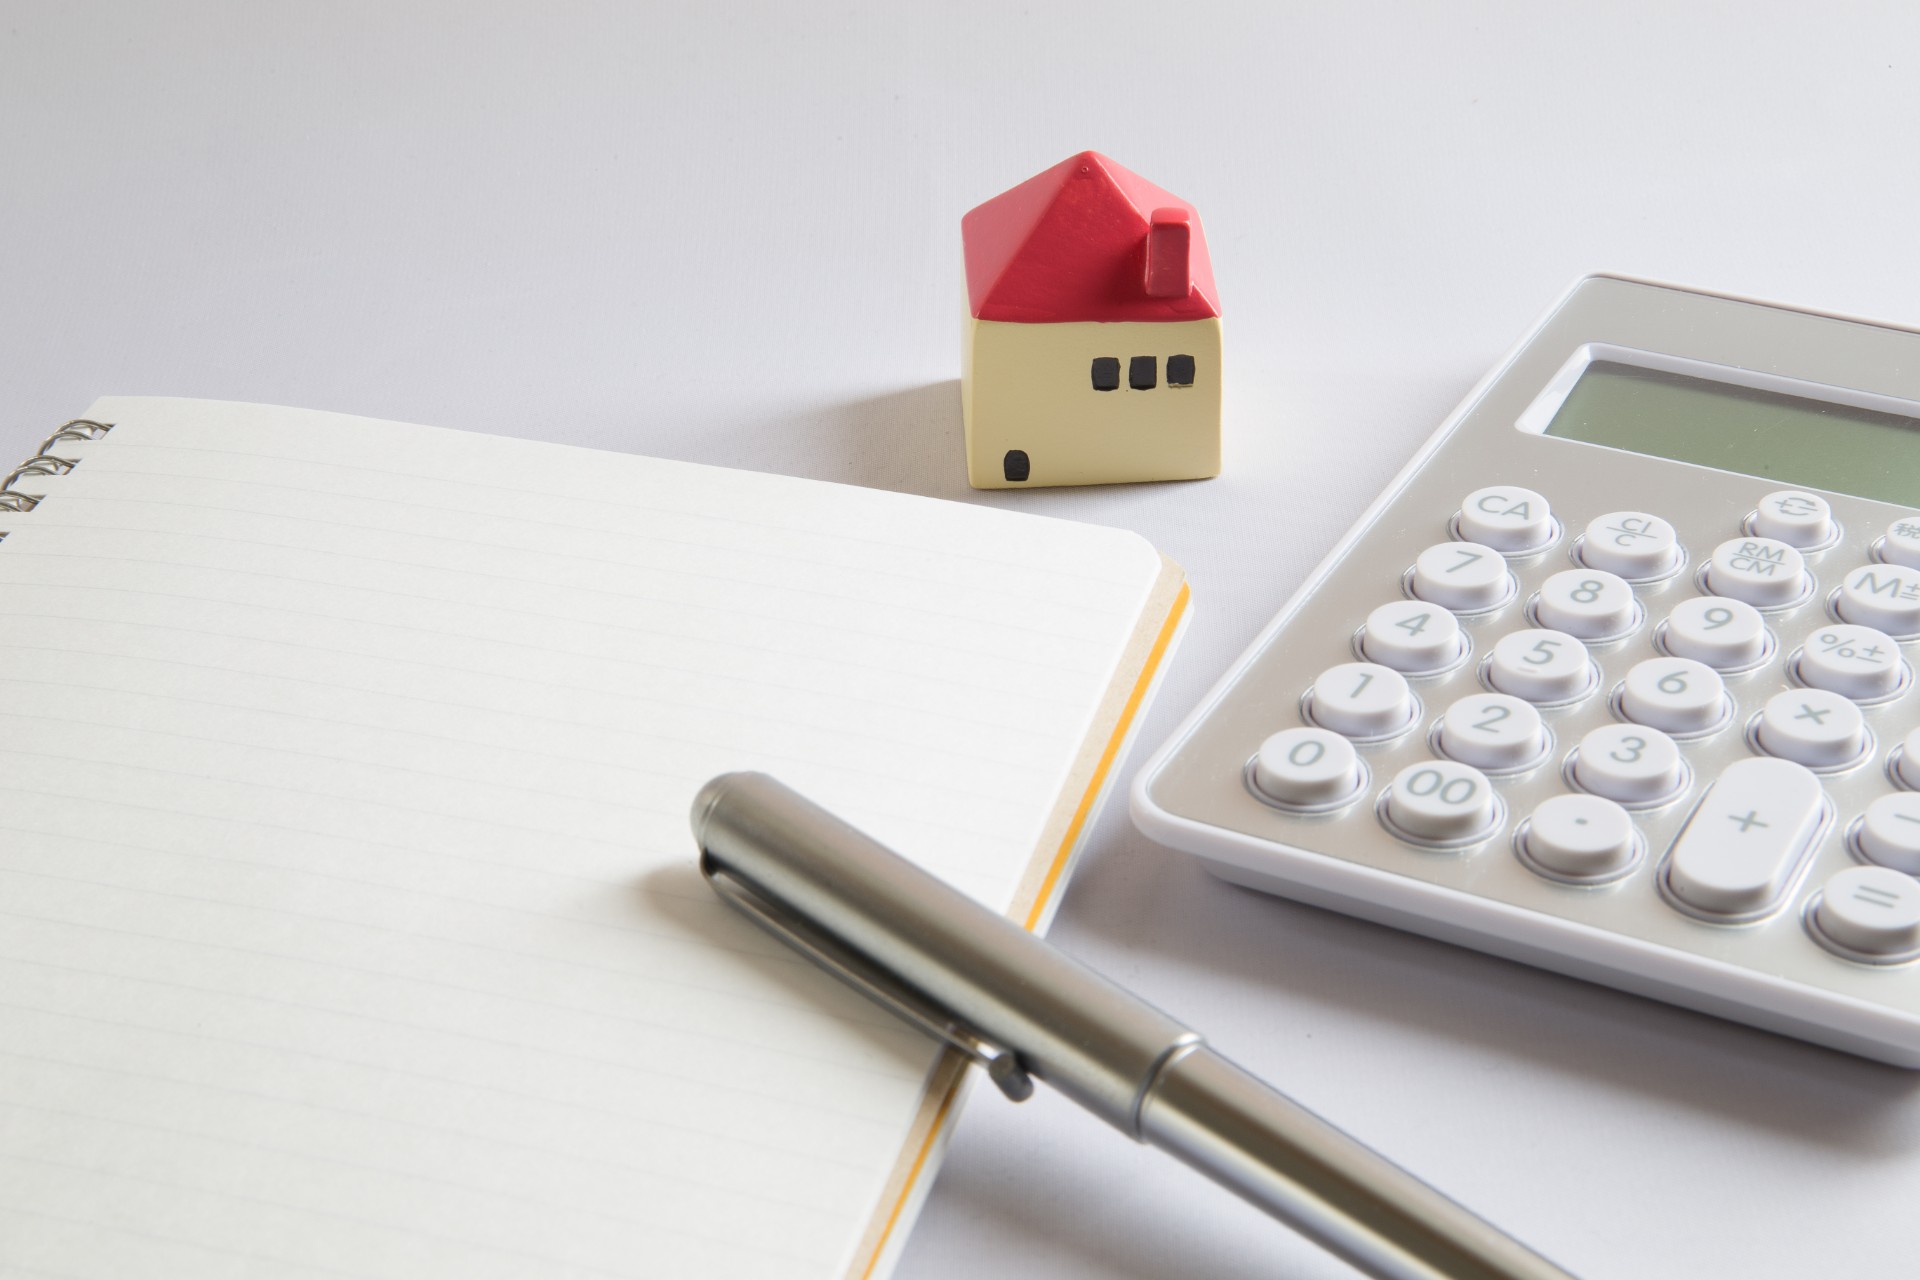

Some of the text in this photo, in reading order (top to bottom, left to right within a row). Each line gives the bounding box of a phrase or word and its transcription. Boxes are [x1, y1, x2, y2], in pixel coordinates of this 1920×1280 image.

[1477, 495, 1530, 520] CA
[1615, 534, 1637, 547] C
[1738, 541, 1785, 562] RM
[1445, 550, 1483, 573] 7
[1729, 557, 1776, 576] CM
[1570, 580, 1604, 604] 8
[1395, 613, 1431, 636] 4
[1703, 607, 1734, 630] 9
[1522, 640, 1562, 665] 5
[1350, 673, 1374, 699] 1
[1657, 671, 1689, 694] 6
[1472, 705, 1511, 733] 2
[1288, 740, 1325, 767] 0
[1609, 736, 1648, 763] 3
[1406, 769, 1477, 805] 00
